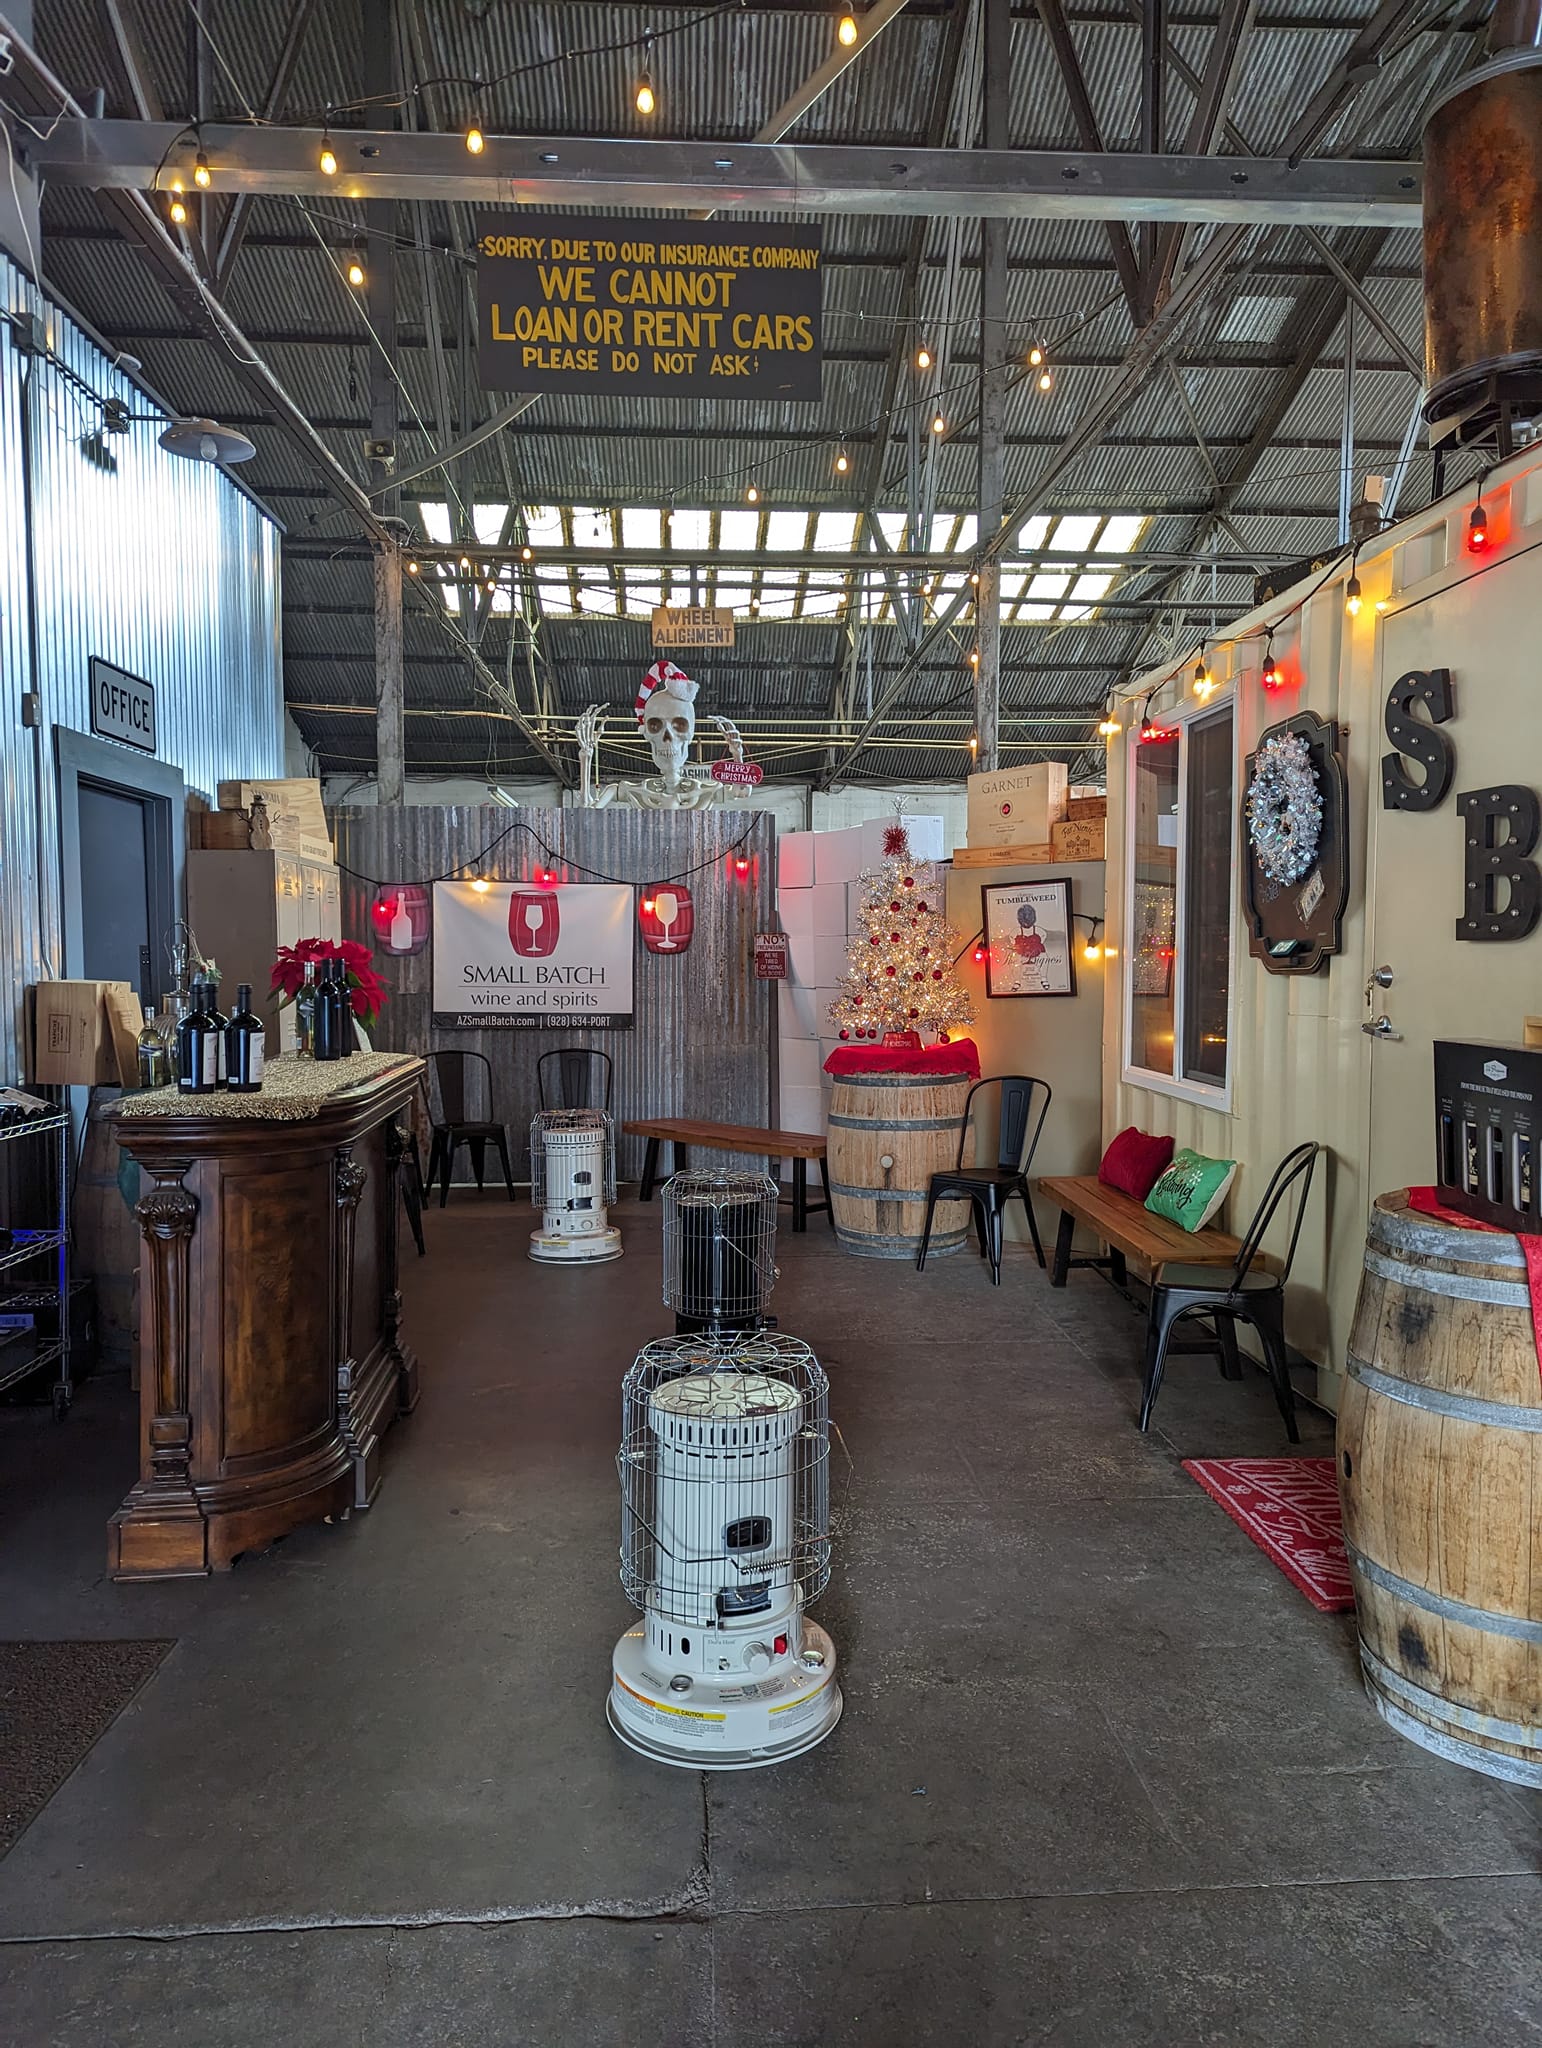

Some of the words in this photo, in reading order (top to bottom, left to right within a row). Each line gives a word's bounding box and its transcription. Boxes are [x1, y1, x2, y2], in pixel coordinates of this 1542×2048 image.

[551, 238, 590, 261] DUE
[592, 240, 617, 262] TO
[620, 241, 656, 264] OUR
[659, 244, 750, 267] INSURANCE
[752, 246, 819, 269] COMPANY
[537, 264, 596, 303] WE
[609, 268, 736, 307] CANNOT
[491, 303, 578, 343] LOAN
[583, 308, 624, 345] OR
[633, 310, 723, 348] RENT
[732, 313, 814, 352] CARS
[522, 346, 599, 371] PLEASE
[611, 350, 640, 372] DO
[653, 352, 697, 374] NOT
[709, 353, 750, 376] ASK
[666, 610, 720, 625] WHEEL
[655, 627, 732, 644] ALIGNMENT
[101, 681, 150, 733] OFFICE
[1382, 668, 1456, 812] S
[715, 771, 758, 783] CHRISTMAS
[724, 763, 751, 774] MERRY
[981, 776, 1033, 794] GARNET
[1455, 784, 1542, 941] B
[995, 893, 1057, 905] TUMBLEWEED
[763, 935, 779, 945] NO
[463, 965, 530, 984] SMALL
[536, 966, 605, 984] BATCH
[471, 990, 511, 1006] wine
[516, 990, 547, 1006] and
[552, 992, 598, 1009] spirits
[457, 1015, 535, 1026] AZSmallBatch.com
[547, 1015, 570, 1027] (928)
[572, 1016, 611, 1027] 634-PORT
[681, 1710, 704, 1718] CAUTION
